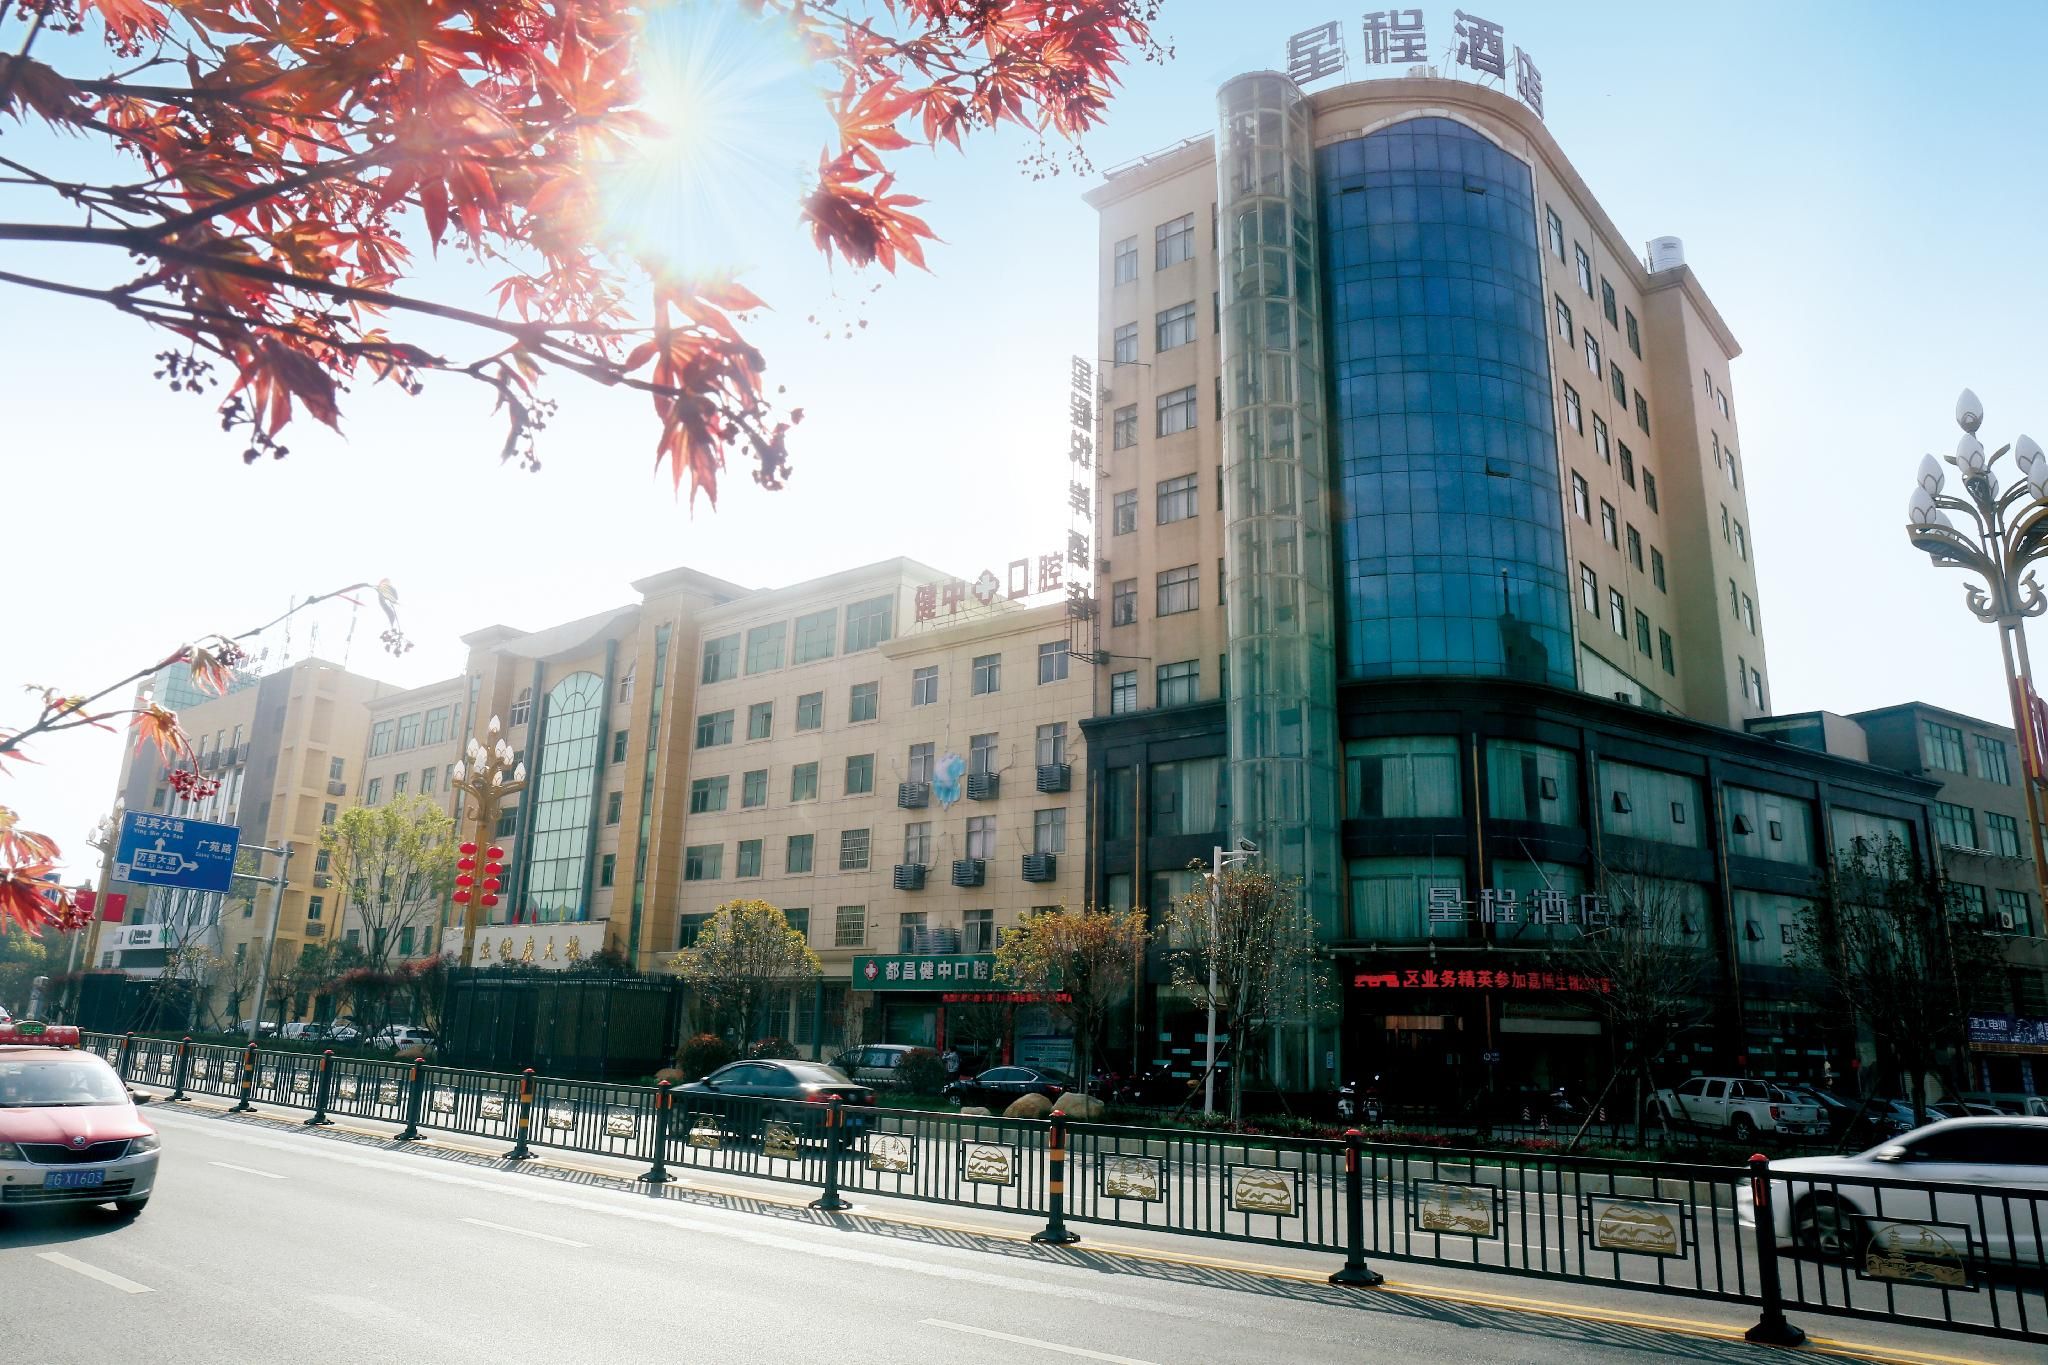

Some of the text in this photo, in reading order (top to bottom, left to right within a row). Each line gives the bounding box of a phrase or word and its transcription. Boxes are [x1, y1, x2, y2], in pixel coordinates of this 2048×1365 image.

[1288, 9, 1544, 121] 星程酒店
[134, 816, 184, 833] 迎宾大道
[196, 839, 232, 855] 广苑路
[137, 852, 177, 866] 万里大道
[1429, 886, 1610, 926] 星程酒店
